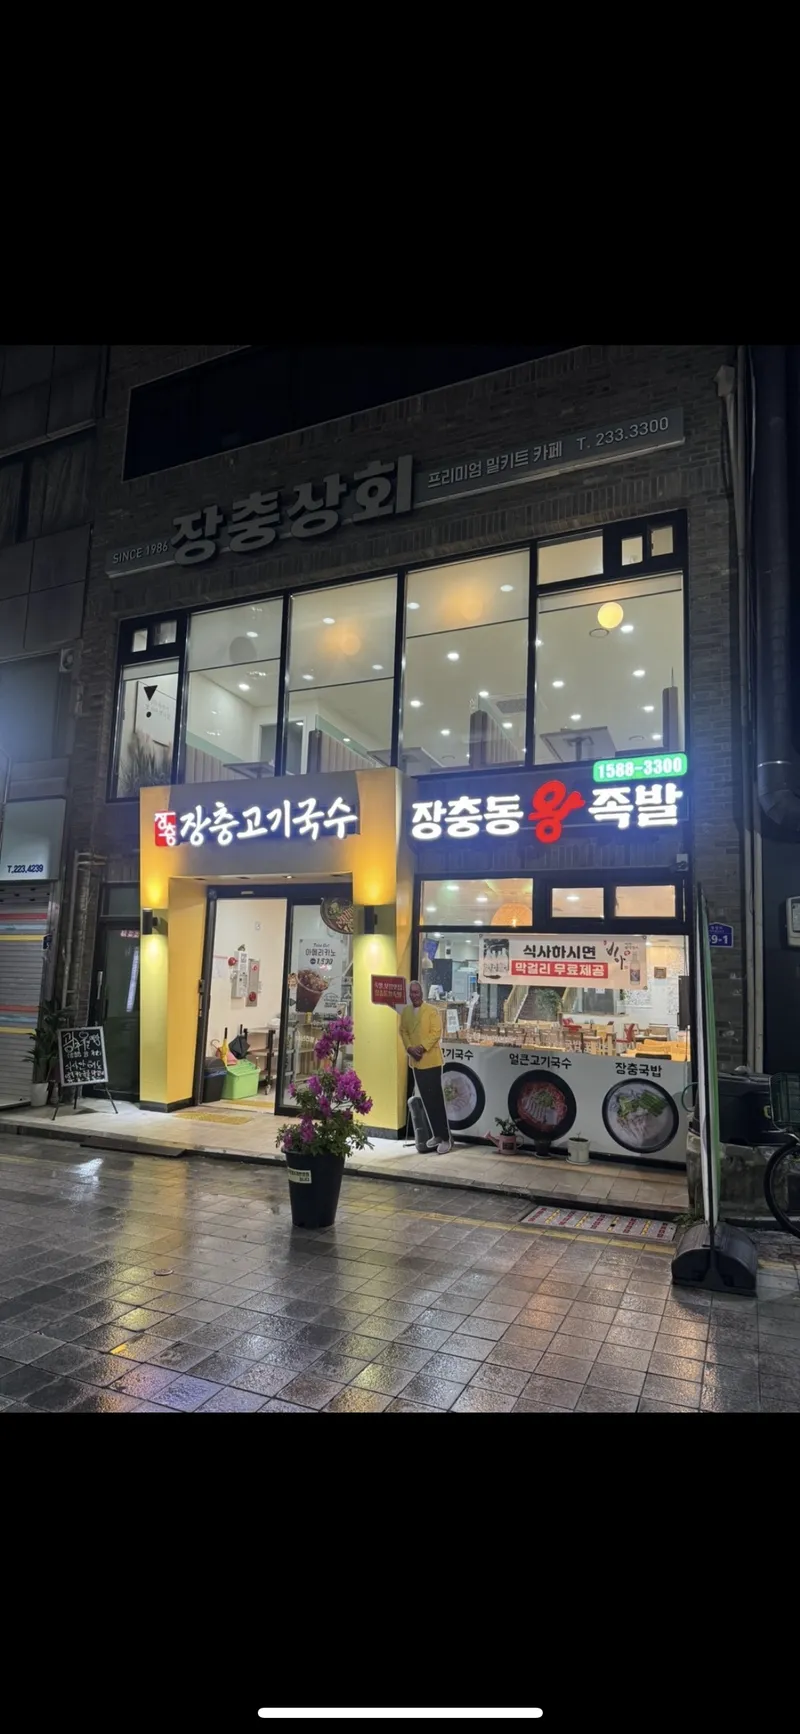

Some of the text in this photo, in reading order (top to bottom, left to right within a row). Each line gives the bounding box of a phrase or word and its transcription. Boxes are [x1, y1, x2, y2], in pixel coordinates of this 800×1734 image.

[427, 416, 670, 490] 프리미엄 밀키트 카페 T. 233.3300
[169, 454, 415, 566] 장충상회
[112, 540, 169, 565] SINCE 1986
[597, 756, 683, 779] 1588-3300
[180, 796, 358, 847] 장충고기국수
[411, 780, 684, 843] 장충동 왕 족발
[305, 948, 336, 957] 아메리카노
[523, 943, 596, 960] 식사하시면
[514, 962, 551, 976] 막걸리
[554, 963, 605, 978] 무료제공
[509, 1052, 573, 1069] 얼큰고기국수
[615, 1062, 662, 1077] 장충국밥
